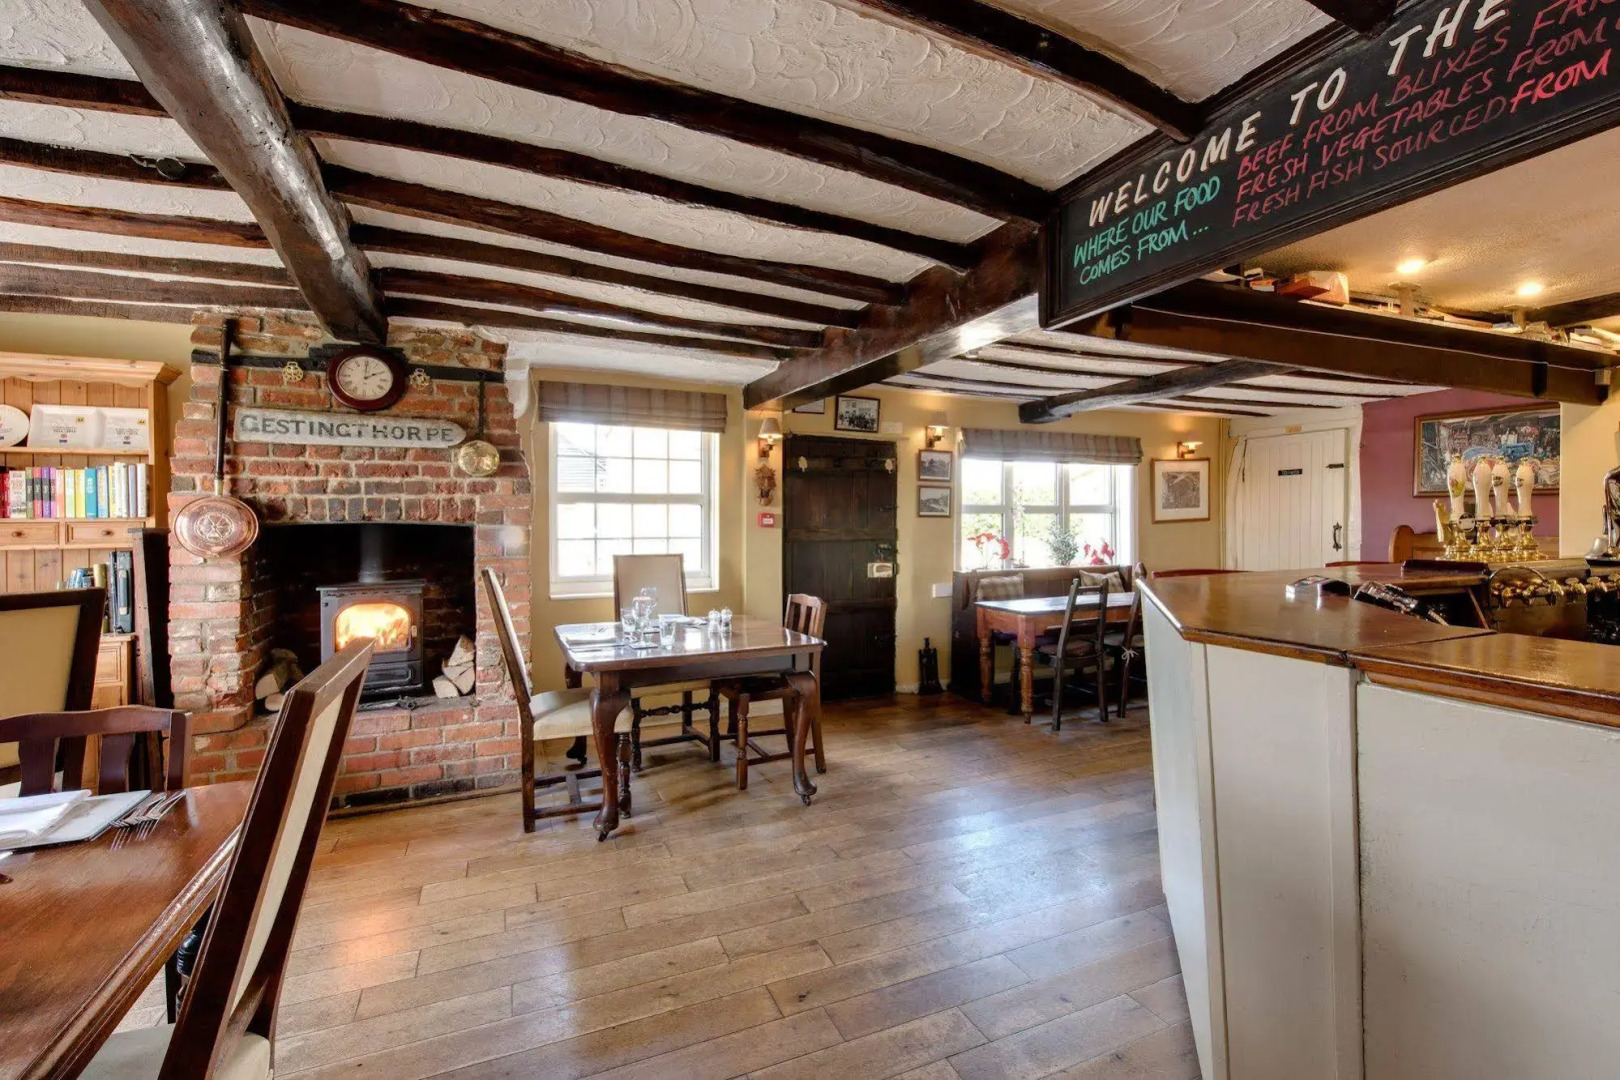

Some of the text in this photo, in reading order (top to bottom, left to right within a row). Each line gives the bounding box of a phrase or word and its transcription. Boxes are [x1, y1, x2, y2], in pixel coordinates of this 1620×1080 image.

[1088, 0, 1507, 227] WELCOME TO THE
[1232, 48, 1612, 227] FRESH FISH SOURCED FROM
[1236, 17, 1607, 203] FRESH VEGETABLES FROM
[1237, 0, 1616, 180] BEEF FROM BLIXES FA
[1074, 176, 1221, 267] WHERE OUR FOOD
[1080, 245, 1131, 285] COMES
[239, 414, 454, 442] GESTINGTHORPE
